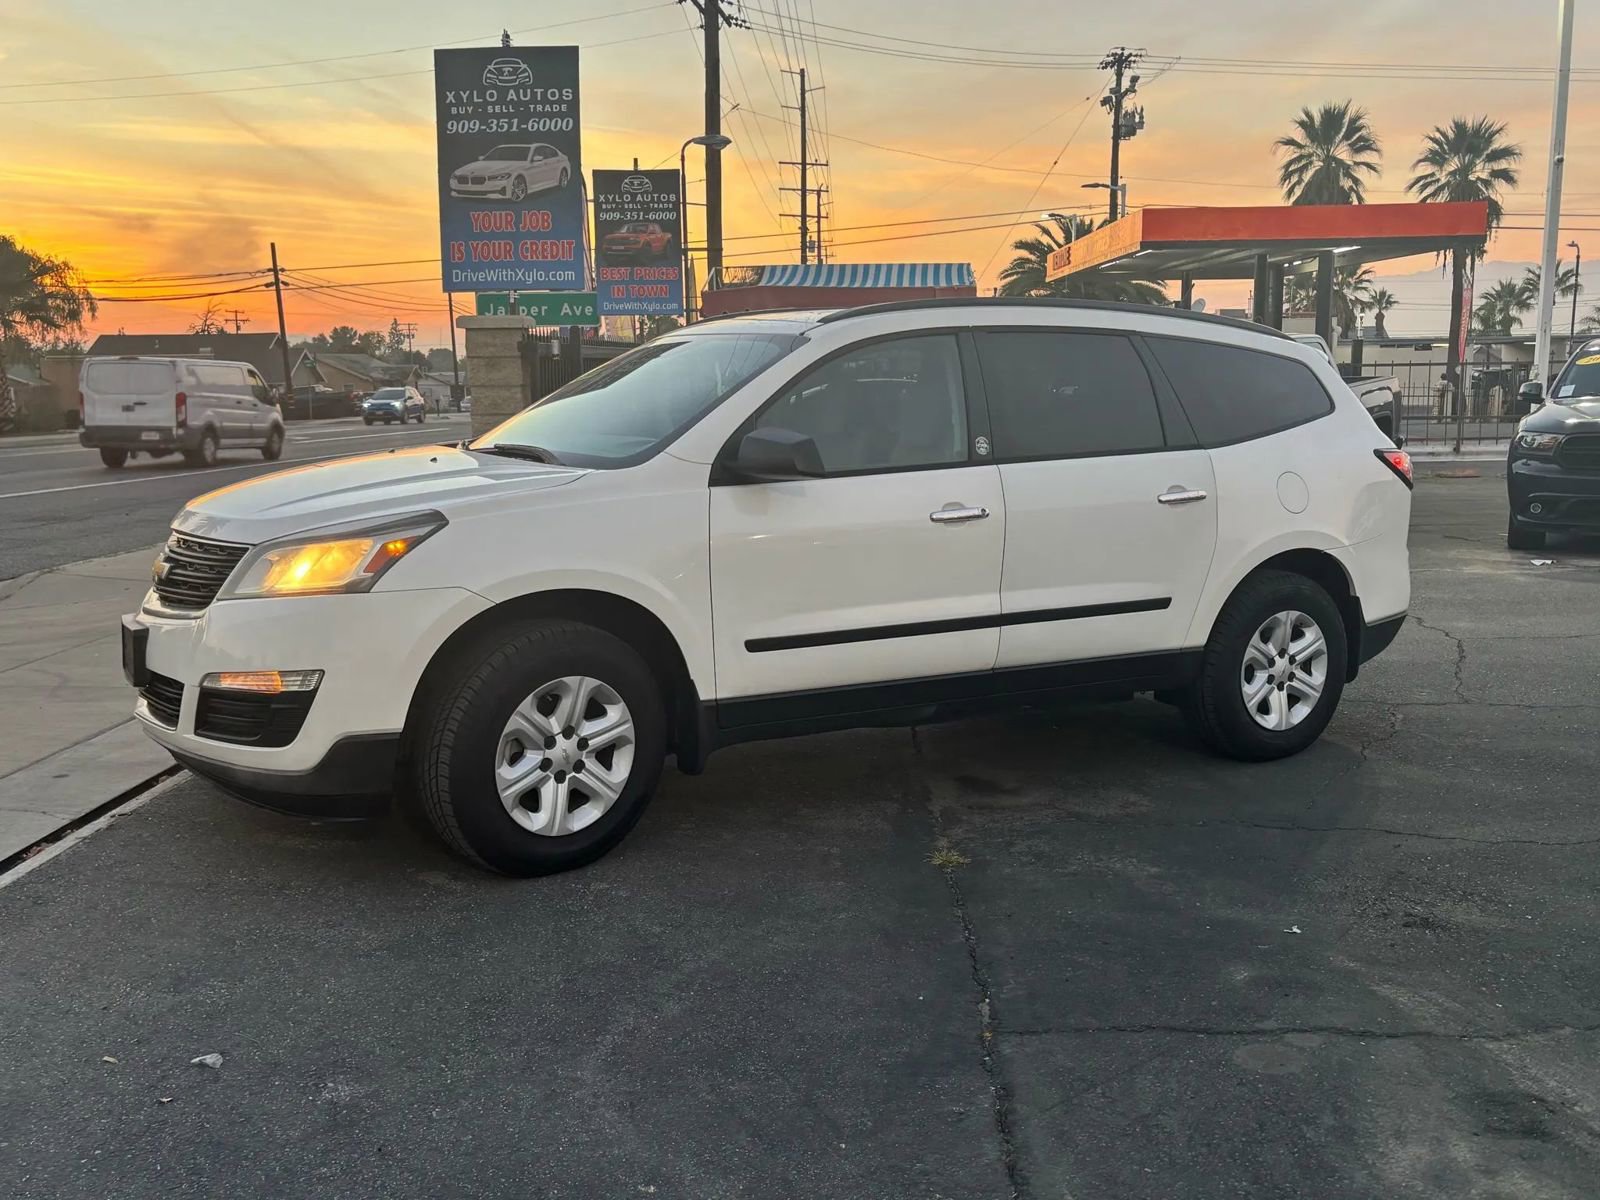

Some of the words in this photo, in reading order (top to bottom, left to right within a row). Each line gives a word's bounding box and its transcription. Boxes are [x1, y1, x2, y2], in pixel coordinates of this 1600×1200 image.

[446, 89, 498, 104] XYLO
[506, 88, 573, 102] AUTOS
[451, 106, 474, 115] BUY
[487, 104, 516, 113] SELL
[529, 104, 568, 112] TRADE
[446, 117, 574, 134] 909-351-6000
[599, 193, 631, 203] XYLO
[636, 193, 677, 202] AUTOS
[470, 210, 516, 233] YOUR
[520, 210, 552, 232] JOB
[599, 211, 677, 221] 909-351-6000
[450, 241, 466, 262] IS
[469, 240, 515, 262] YOUR
[518, 239, 576, 261] CREDIT
[452, 268, 575, 284] DriveWithXylo.com
[600, 267, 631, 281] BEST
[634, 266, 679, 281] PRICES
[611, 285, 626, 299] IN
[628, 284, 669, 298] TOWN
[485, 303, 548, 317] Japer
[560, 302, 594, 316] Ave
[603, 301, 679, 312] DriveWithXylo.com
